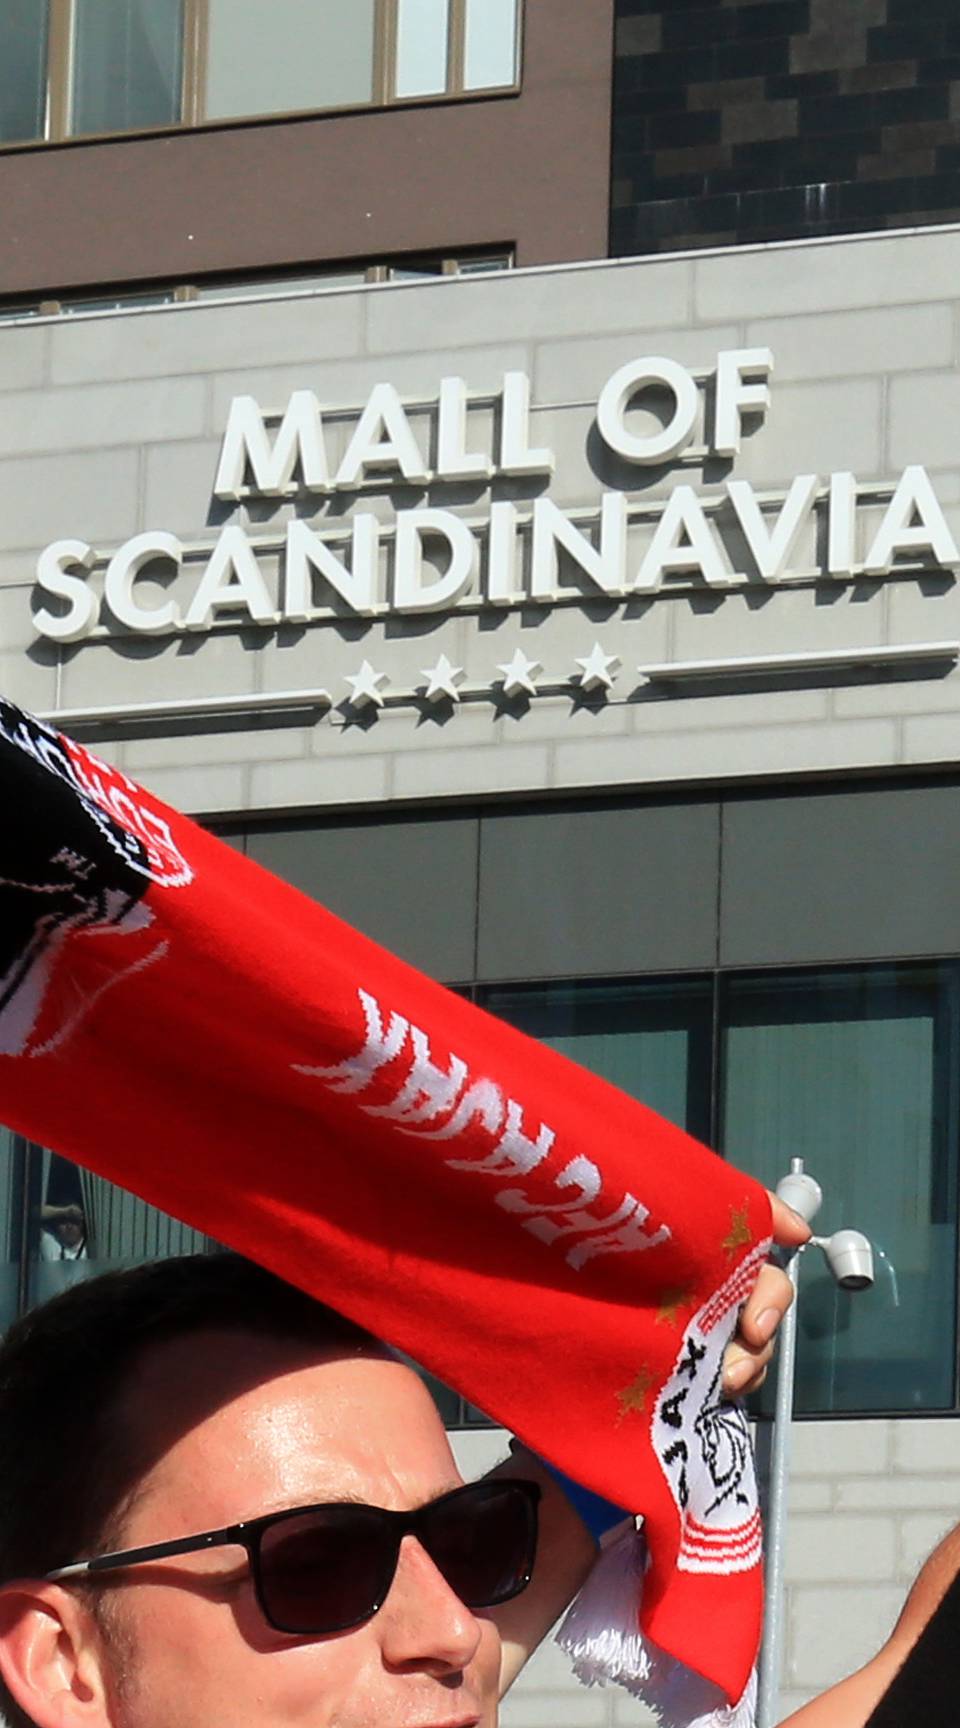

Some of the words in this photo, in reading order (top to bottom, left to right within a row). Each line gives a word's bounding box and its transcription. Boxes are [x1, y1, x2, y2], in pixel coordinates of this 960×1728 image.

[214, 371, 556, 499] MALL
[596, 347, 774, 466] OF
[32, 465, 960, 643] SCANDINAVIA
[290, 988, 555, 1177] AJAX
[495, 1153, 671, 1272] AFC
